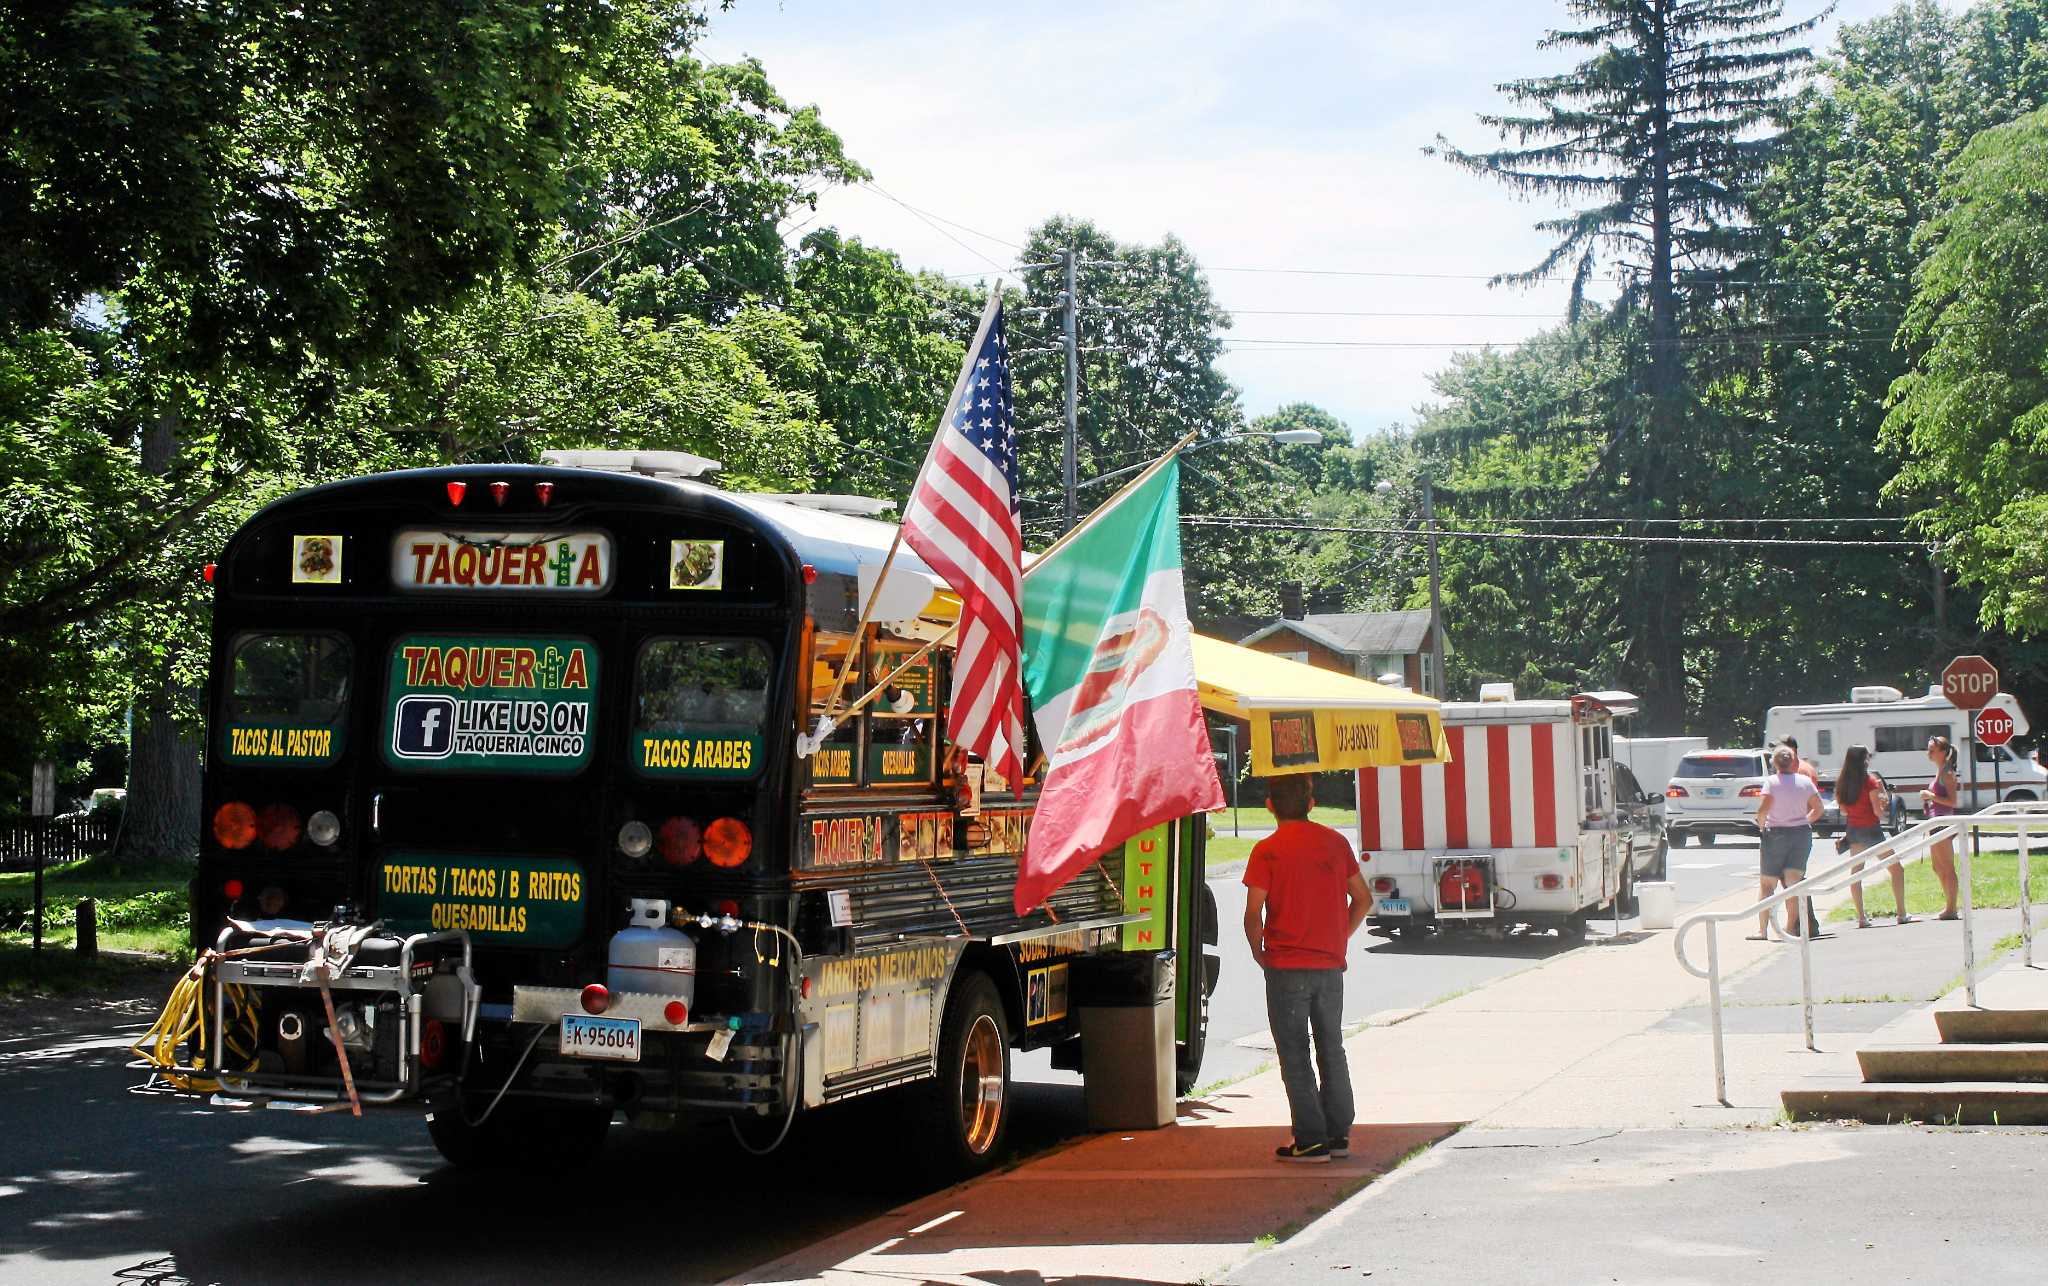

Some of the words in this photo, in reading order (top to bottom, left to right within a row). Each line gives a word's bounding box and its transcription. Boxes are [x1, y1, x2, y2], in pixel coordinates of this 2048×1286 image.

[1946, 673, 1994, 694] STOP
[457, 701, 511, 732] LIKE
[515, 702, 548, 733] US
[551, 702, 588, 734] ON
[1977, 719, 2012, 734] STOP
[232, 729, 268, 756] TACOS
[269, 729, 284, 756] AL
[287, 730, 331, 757] PASTOR
[456, 735, 532, 756] TAQUERIA
[533, 736, 584, 756] CINCO
[643, 739, 690, 767] TACOS
[693, 740, 751, 769] ARABES
[384, 865, 437, 895] TORTAS
[451, 868, 496, 897] TACOS
[431, 903, 527, 933] QUESADILLAS
[818, 955, 877, 998] JARRITOS
[880, 947, 945, 987] MEXICANOS
